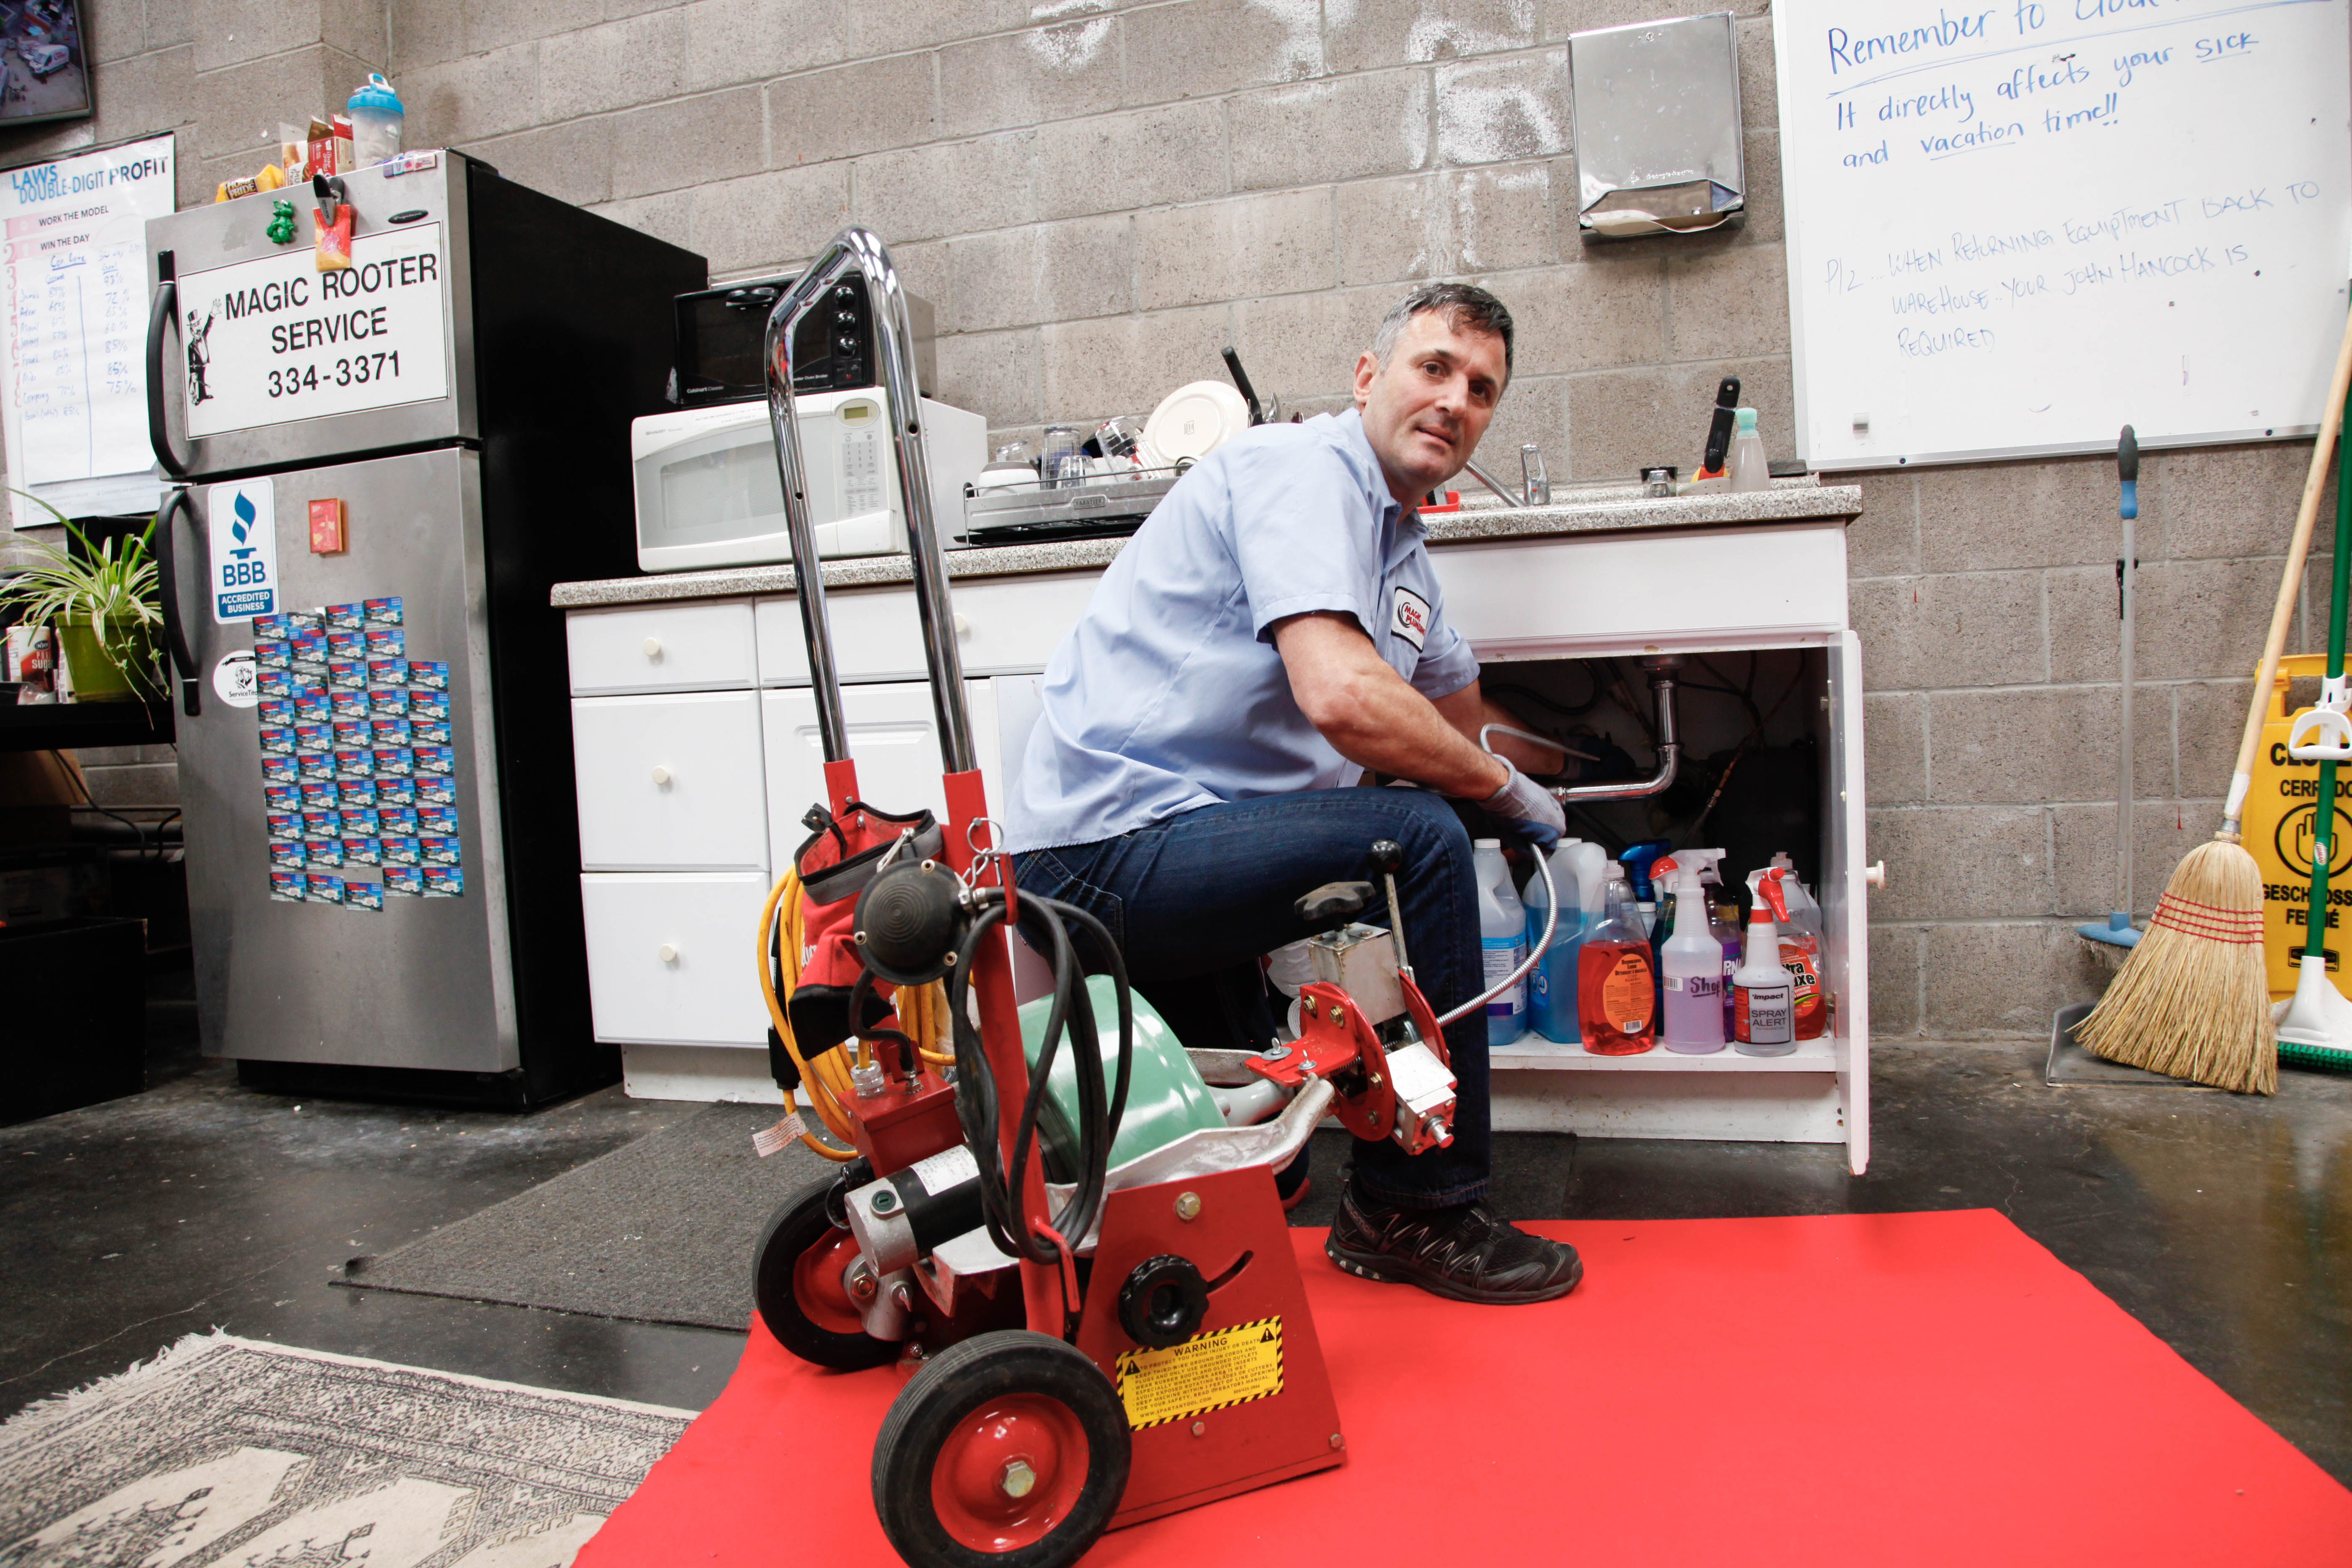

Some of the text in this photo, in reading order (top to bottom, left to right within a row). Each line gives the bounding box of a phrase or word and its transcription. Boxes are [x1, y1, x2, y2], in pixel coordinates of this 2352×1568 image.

[1828, 9, 1996, 74] Remember
[2013, 0, 2045, 35] to
[1878, 84, 1975, 124] directly
[1996, 61, 2090, 100] affects
[2114, 46, 2174, 88] your
[1843, 92, 2119, 168] and vacation time!!
[12, 165, 58, 190] LAWS
[19, 156, 168, 204] DOUBLE-DIGIT PROFIT
[227, 178, 255, 191] HOME
[228, 183, 255, 198] PRIDE
[39, 212, 62, 227] WORK
[64, 211, 79, 221] THE
[81, 205, 109, 218] MODEL
[1888, 248, 1943, 276] WHEN
[2201, 187, 2274, 219] BACK
[2286, 181, 2320, 204] TO
[40, 240, 56, 251] WIN
[57, 237, 72, 248] THE
[74, 234, 90, 244] DAY
[225, 253, 437, 320] MAGIC ROOTER
[2001, 274, 2051, 309] YOUR
[2063, 262, 2114, 295] JOHN
[2120, 246, 2216, 283] HANCOCK
[2226, 244, 2248, 266] IS
[271, 306, 388, 354] SERVICE
[268, 350, 400, 398] 334-3371
[1075, 498, 1102, 506] SABATIER
[223, 561, 266, 587] BBB
[221, 591, 270, 605] ACCREDITED
[227, 601, 265, 614] BUSINESS
[2280, 779, 2352, 798] CERRDO
[1751, 1008, 1786, 1018] SPRAY
[1752, 1017, 1786, 1026] ALERT
[1174, 1337, 1228, 1357] WARNING
[1149, 1359, 1175, 1369] PROTECT
[1190, 1357, 1214, 1366] GROUND
[1200, 1358, 1231, 1369] GROUNDED
[1233, 1351, 1257, 1361] OUTLETS
[1155, 1376, 1178, 1385] RUBBER
[1234, 1357, 1257, 1366] INSERTS
[1156, 1386, 1183, 1396] EXPOSED
[1185, 1378, 1213, 1389] ROTATING
[1215, 1372, 1236, 1381] BLADES
[1248, 1364, 1272, 1373] CUTTERS
[1136, 1383, 1172, 1395] ESPECIALLY
[1154, 1392, 1180, 1401] MACHINE
[1183, 1386, 1203, 1394] WITHIN
[1211, 1381, 1244, 1393] OPERATORS
[1140, 1397, 1212, 1418] WWW.SPARTANTOOL.COM
